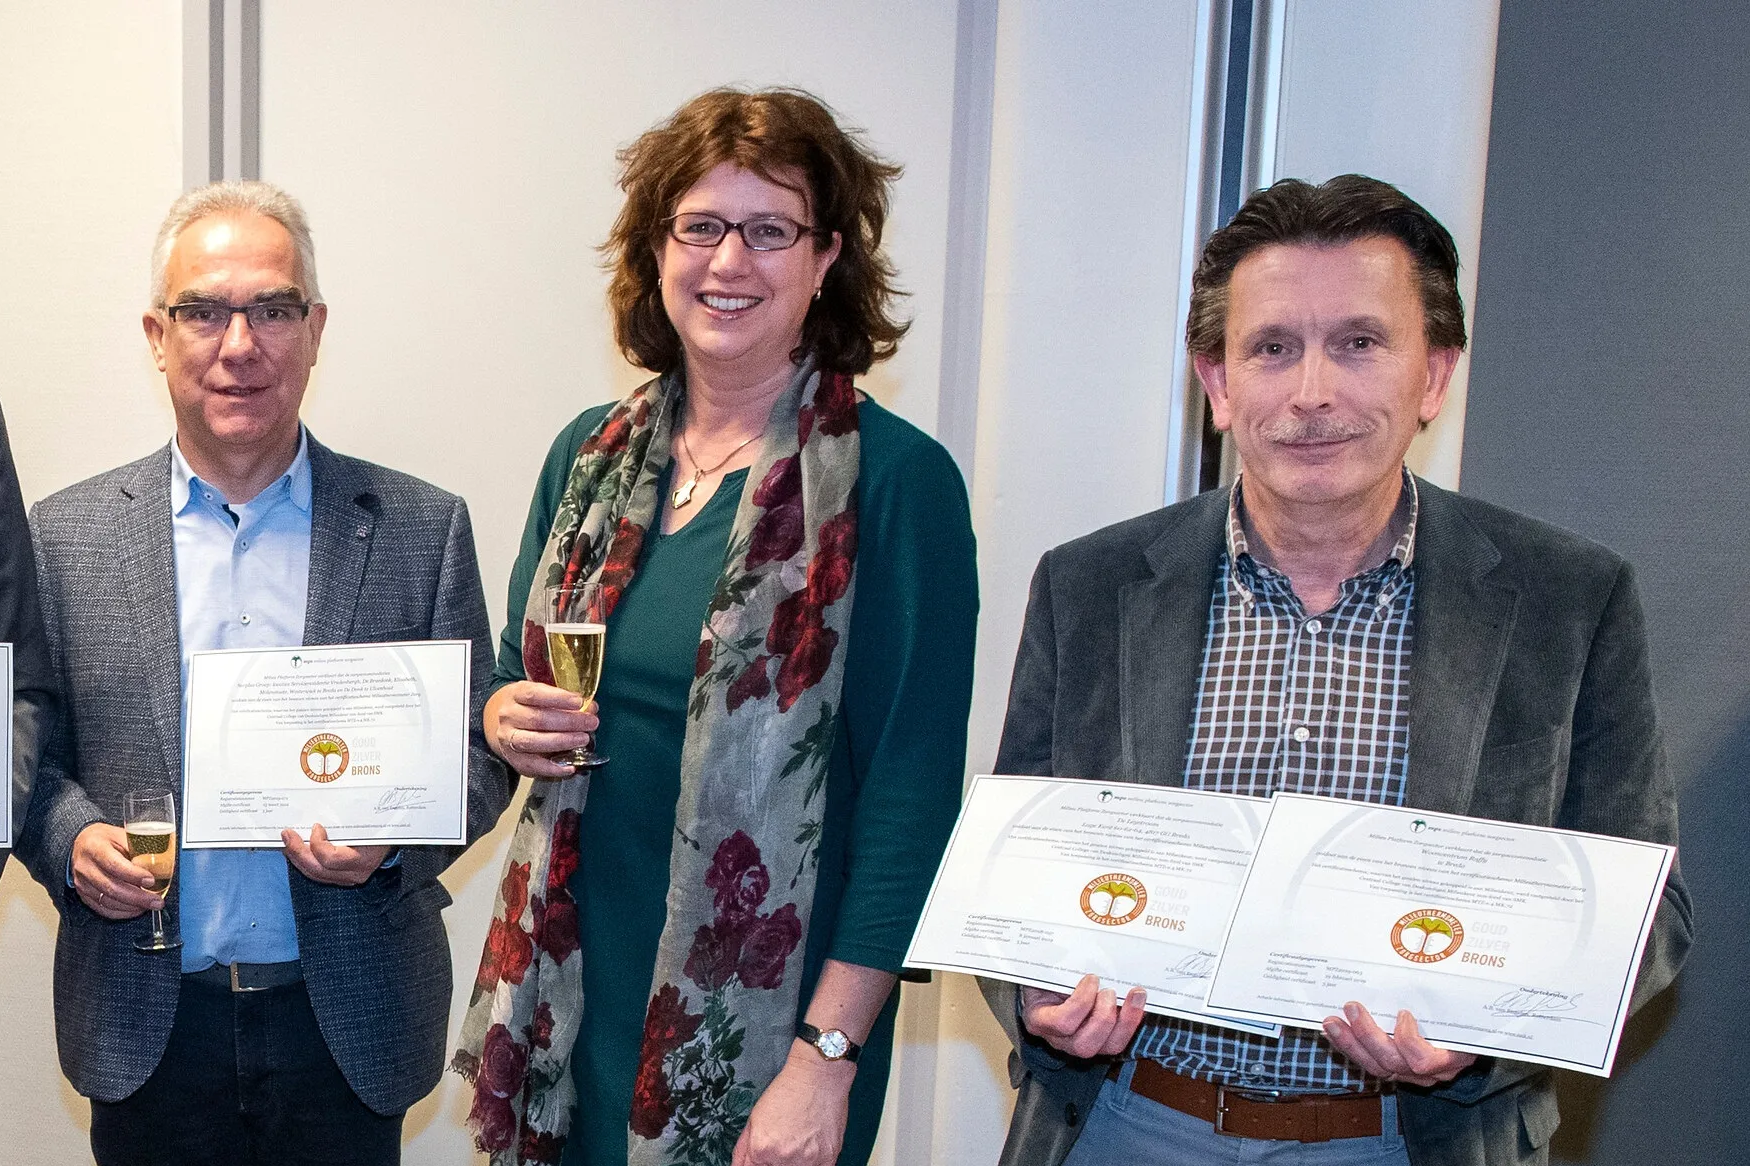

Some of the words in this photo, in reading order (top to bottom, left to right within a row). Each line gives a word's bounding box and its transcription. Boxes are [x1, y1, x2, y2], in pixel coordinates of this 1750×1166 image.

[303, 734, 348, 754] MILIEUTHERMOMETER
[308, 770, 342, 782] ZORGSECTOR
[351, 764, 381, 776] BRONS
[1086, 874, 1147, 900] MILIEUTHERMOMETER
[1083, 908, 1132, 926] ZORGSECTOR
[1144, 914, 1186, 932] BRONS
[1399, 910, 1464, 936] MILIEUTHERMOMETER
[1394, 945, 1446, 964] ZORGSECTOR
[1461, 951, 1506, 968] BRONS
